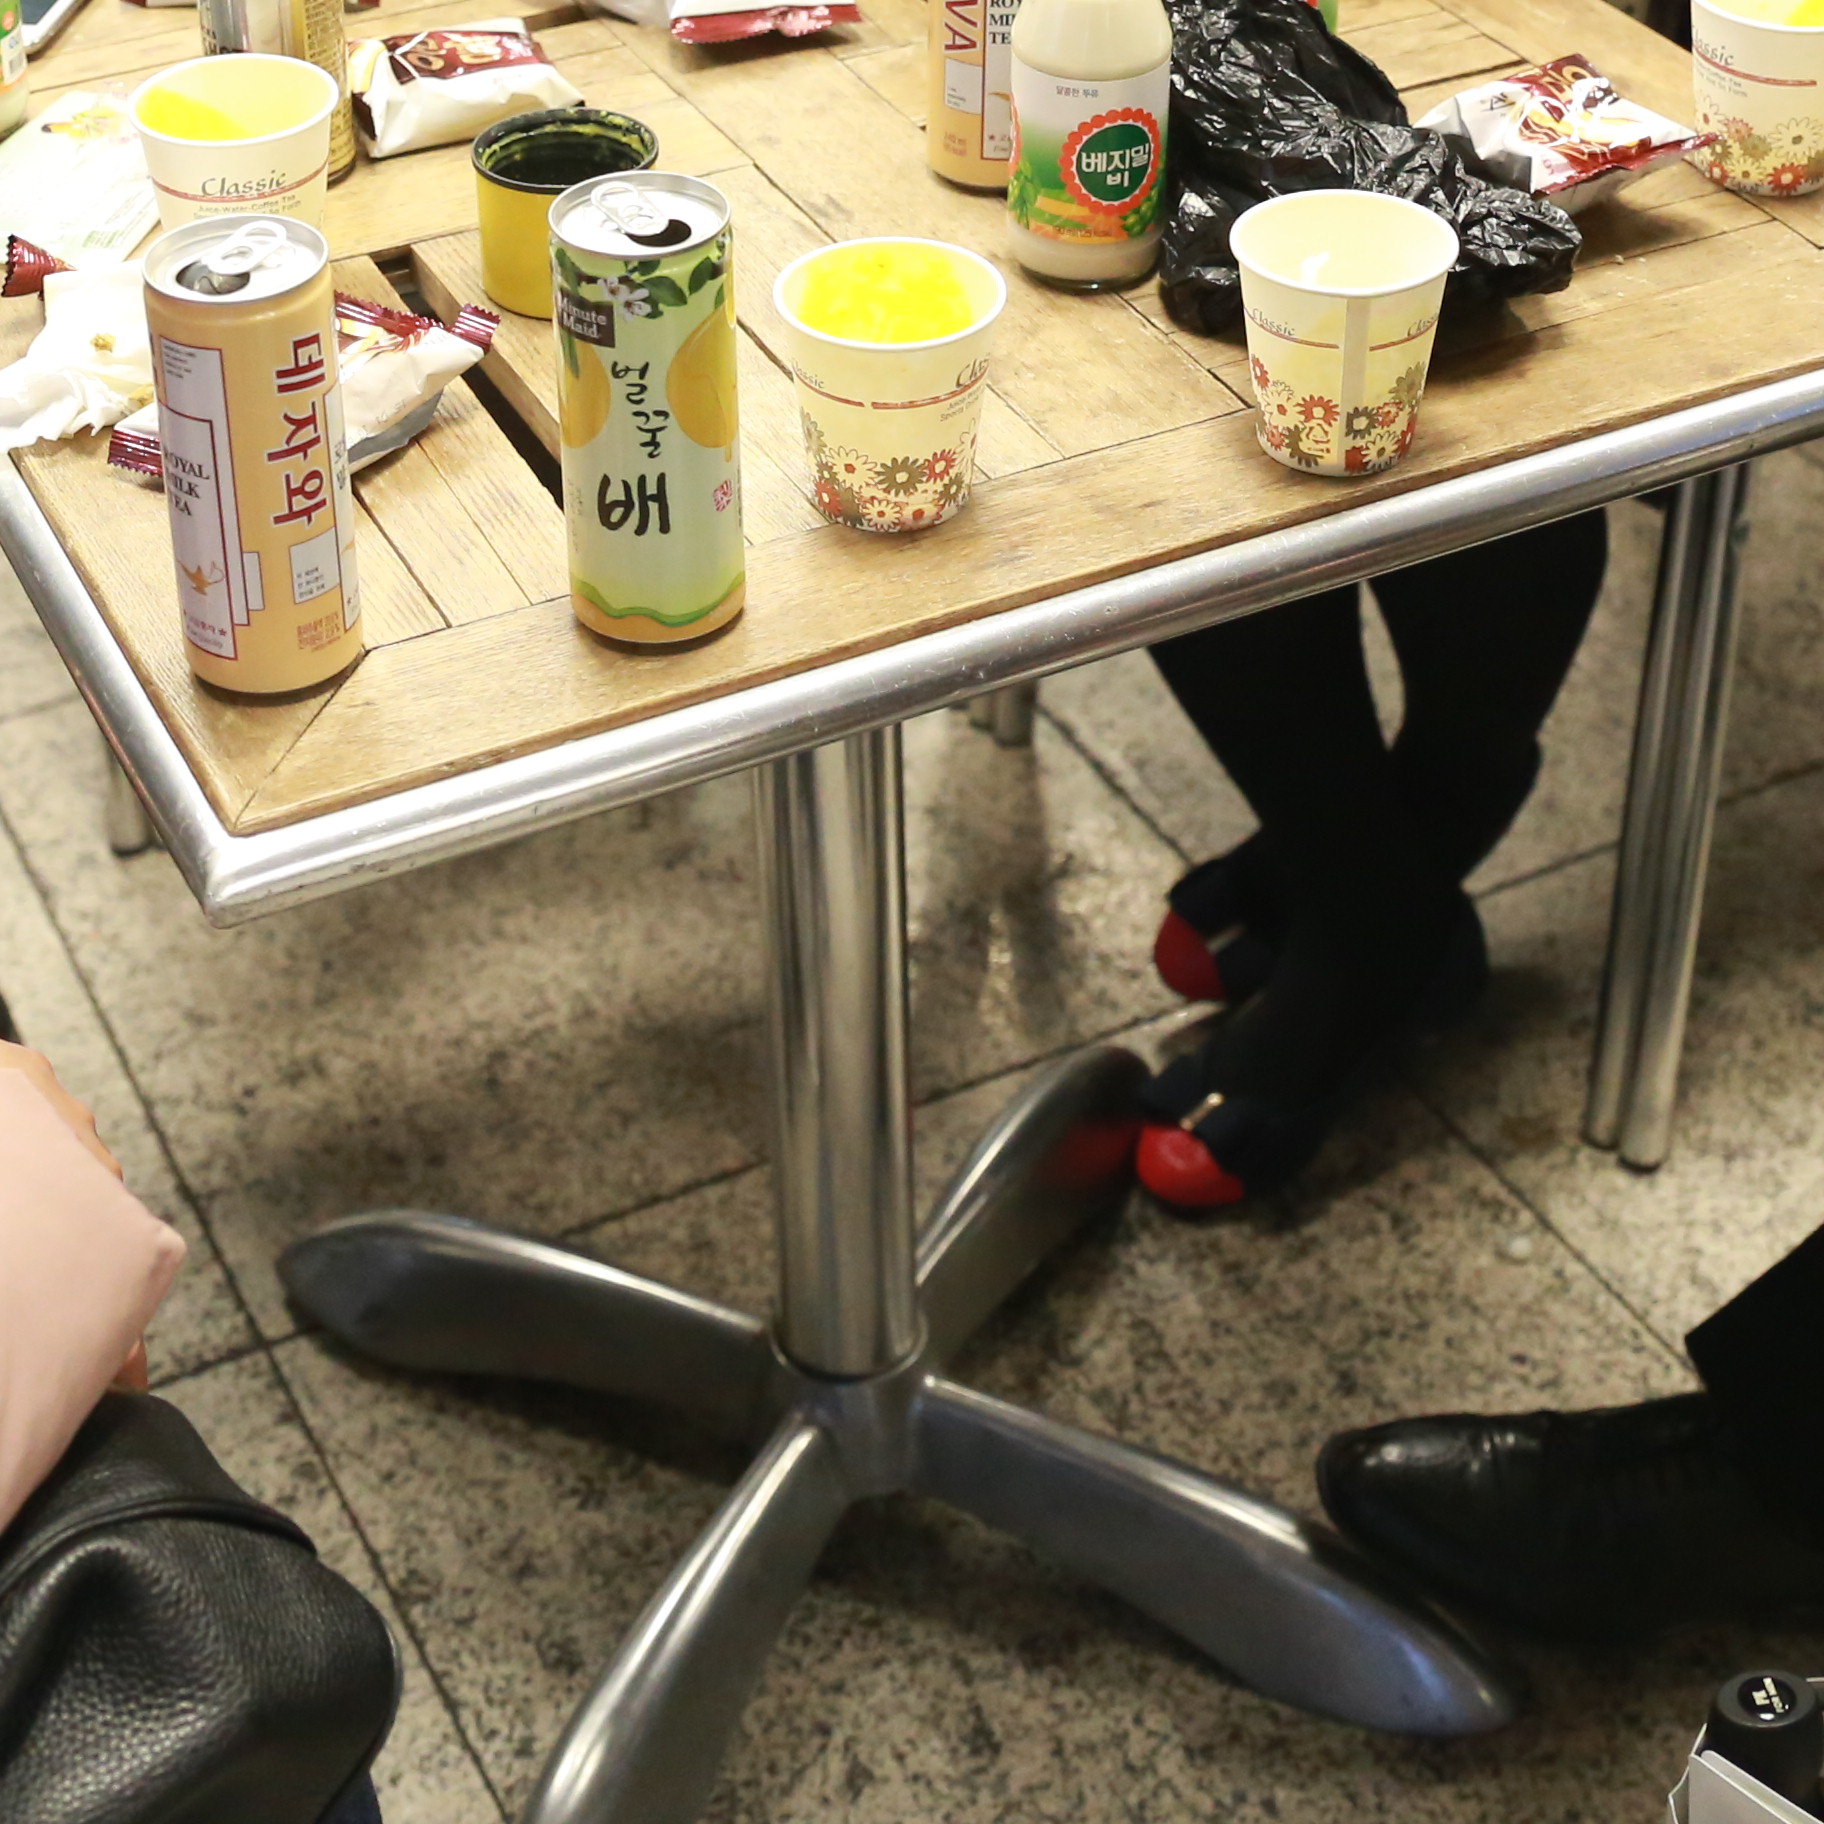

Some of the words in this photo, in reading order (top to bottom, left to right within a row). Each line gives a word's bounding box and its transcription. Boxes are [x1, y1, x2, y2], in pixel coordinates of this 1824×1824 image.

[988, 12, 1017, 27] MI
[988, 31, 1012, 45] TE
[1080, 142, 1150, 173] 베지밀
[201, 169, 288, 198] Classic
[1105, 171, 1130, 188] 비
[557, 292, 608, 326] Minute
[562, 313, 599, 340] Maid
[610, 360, 671, 459] 벌꿀
[266, 332, 328, 526] 데자와
[596, 471, 672, 537] 배
